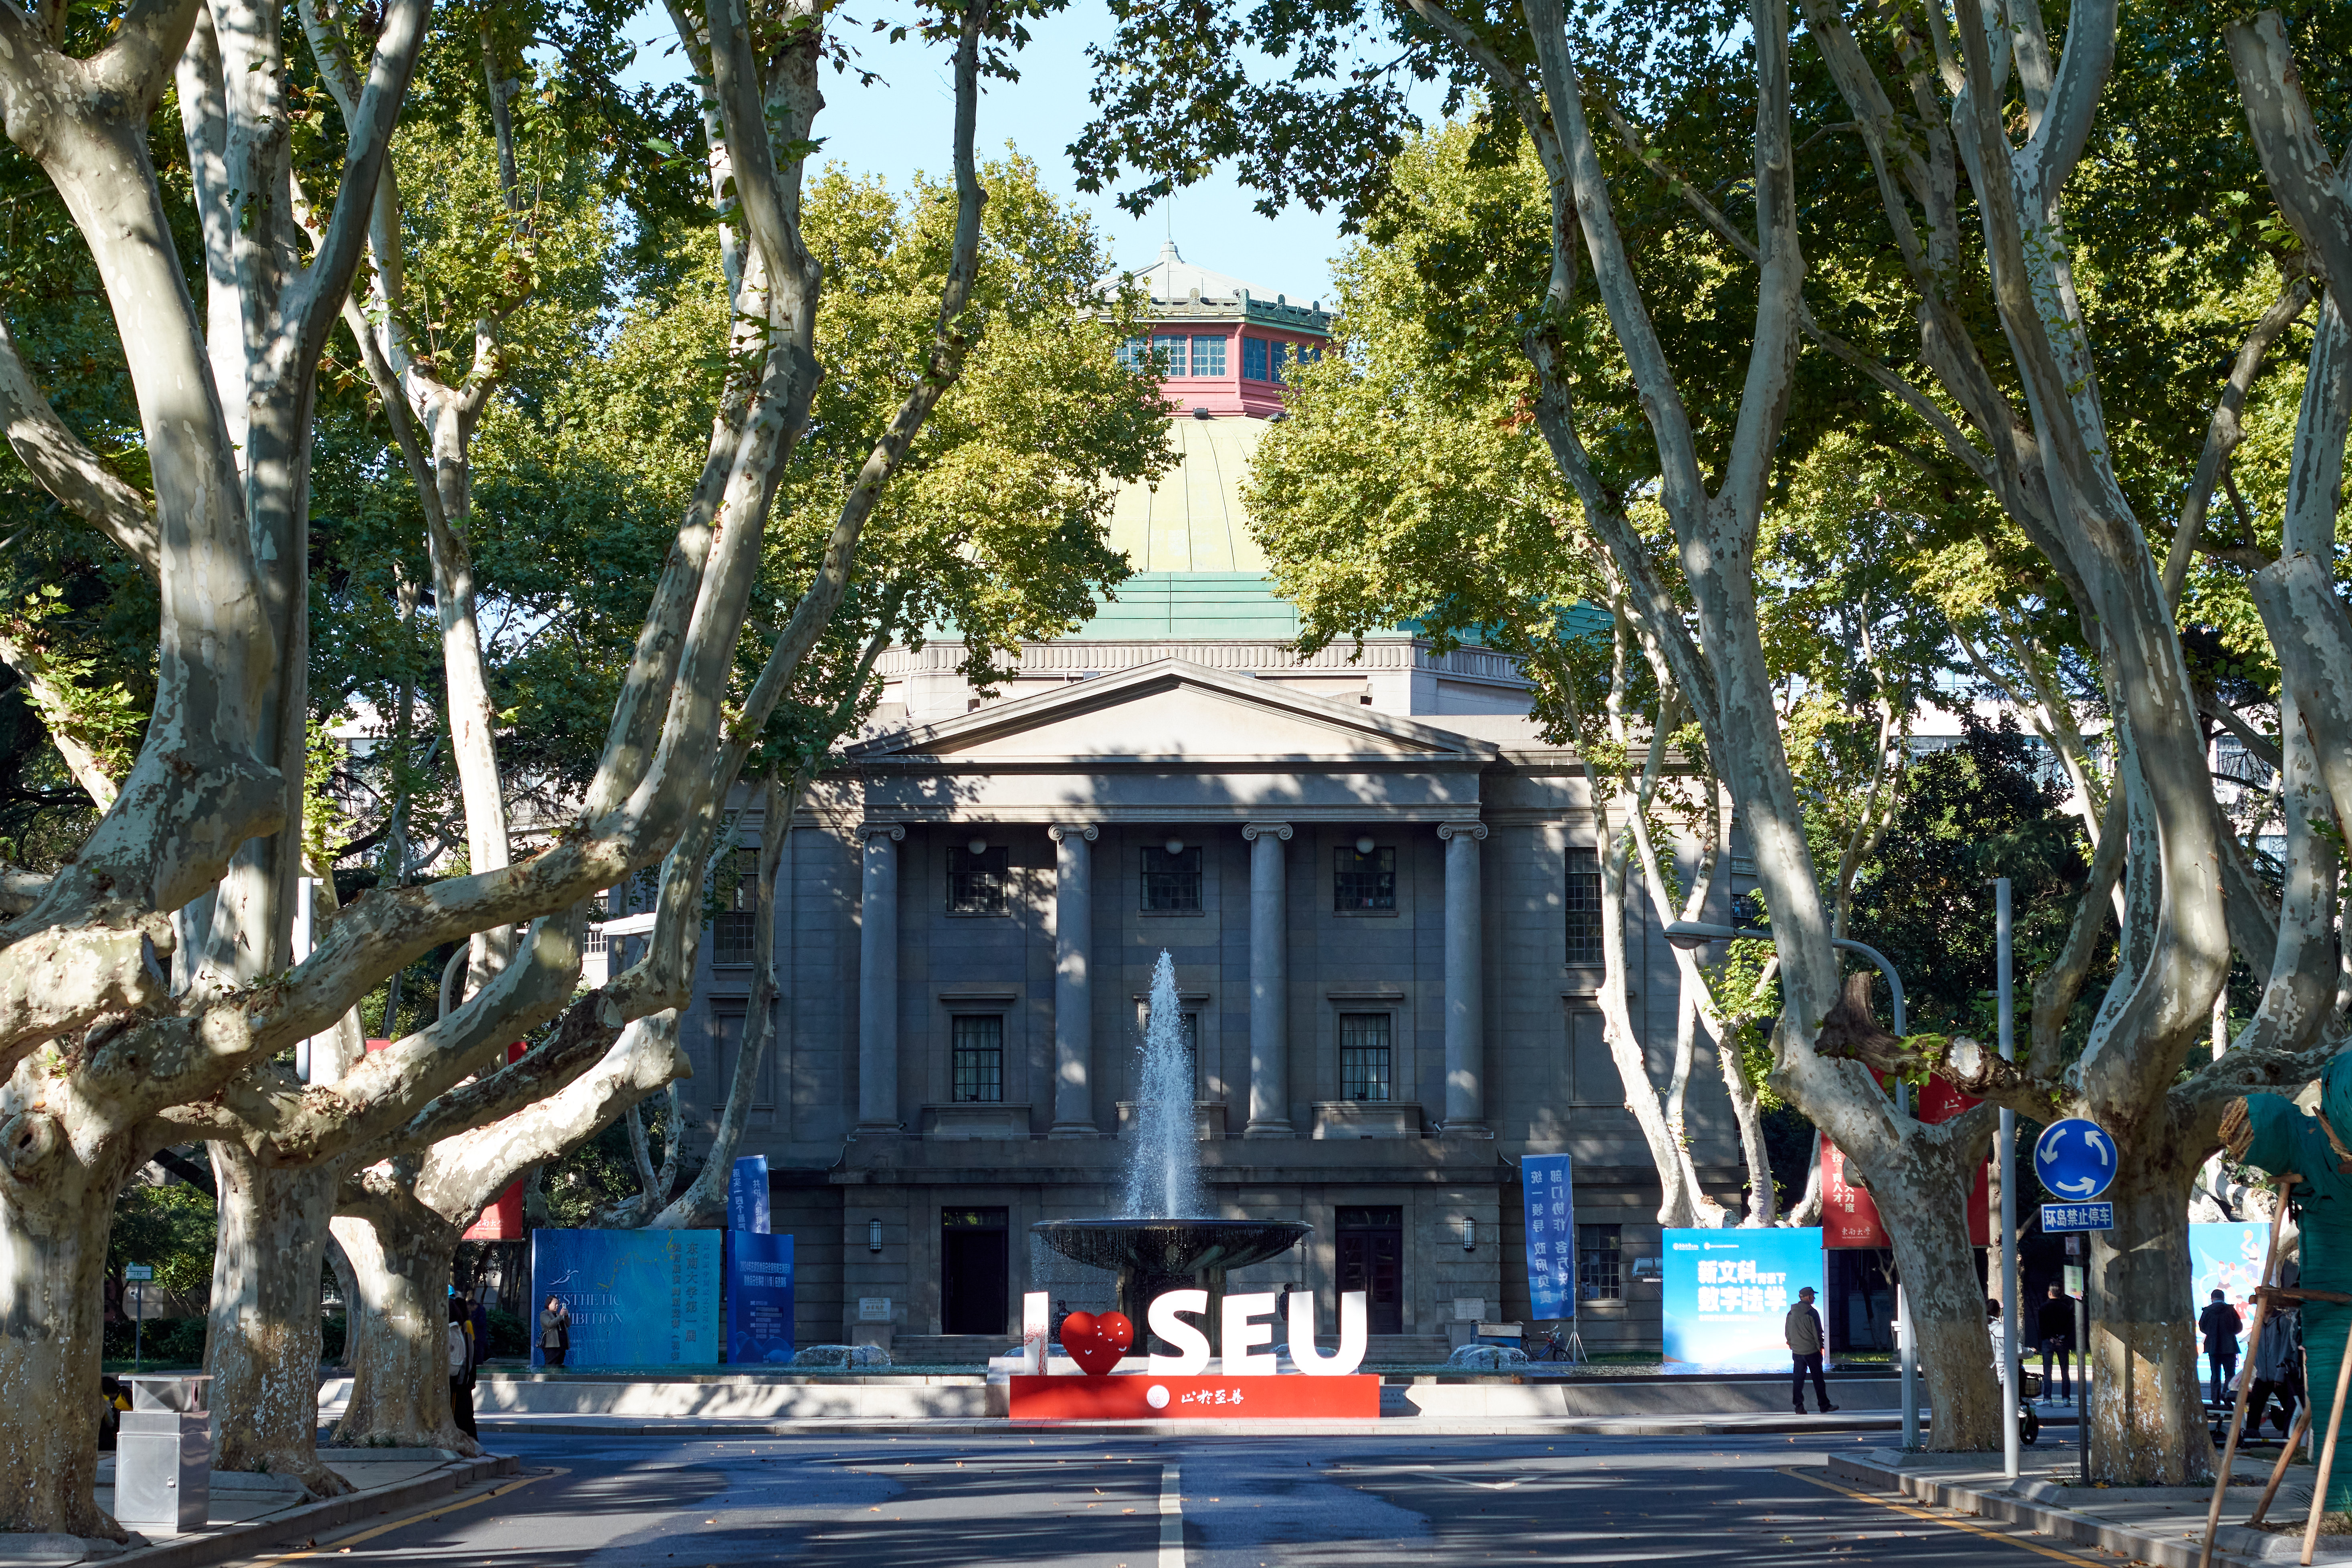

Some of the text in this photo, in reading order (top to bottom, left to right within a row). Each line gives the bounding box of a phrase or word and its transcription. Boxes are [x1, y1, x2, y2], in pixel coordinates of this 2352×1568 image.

[2045, 1207, 2110, 1228] 环岛禁止停车
[547, 1294, 621, 1305] ESTHETIC
[685, 1242, 698, 1343] 东南大学第一届
[1698, 1286, 1787, 1312] 数字法学
[1147, 1289, 1367, 1376] SEU
